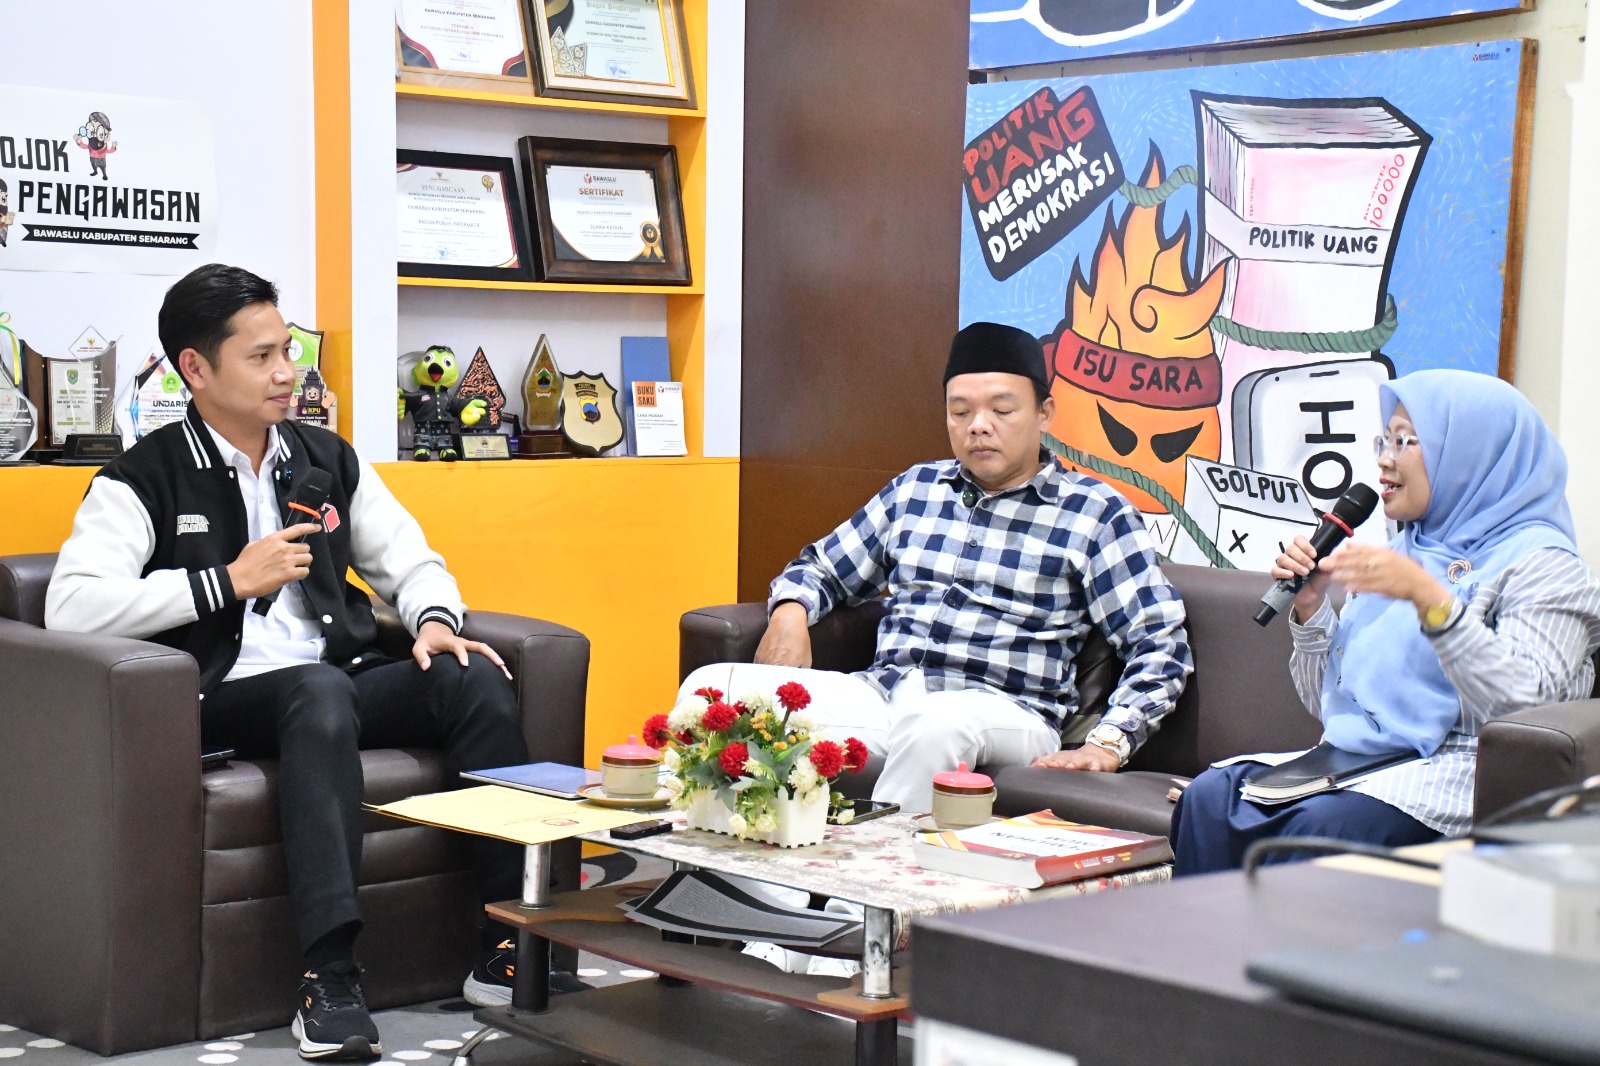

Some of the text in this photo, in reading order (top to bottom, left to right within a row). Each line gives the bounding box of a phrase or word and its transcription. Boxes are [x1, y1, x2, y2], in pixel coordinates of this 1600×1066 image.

[964, 89, 1054, 176] POLITIK
[972, 91, 1096, 204] UANG
[18, 180, 200, 223] PENGAWASAN
[579, 188, 624, 196] SERTIFIKAT
[978, 142, 1088, 232] MERUSAK
[988, 152, 1115, 263] DEMOKRASI
[1370, 154, 1405, 228] 100000
[33, 229, 188, 245] BAWASLU KABUPATEN SEMARANG
[1249, 226, 1378, 254] POLITIK UANG
[637, 386, 655, 395] BUKU
[1073, 345, 1204, 393] ISU SARA
[638, 397, 655, 406] SAKU
[1206, 466, 1300, 504] GOLPUT
